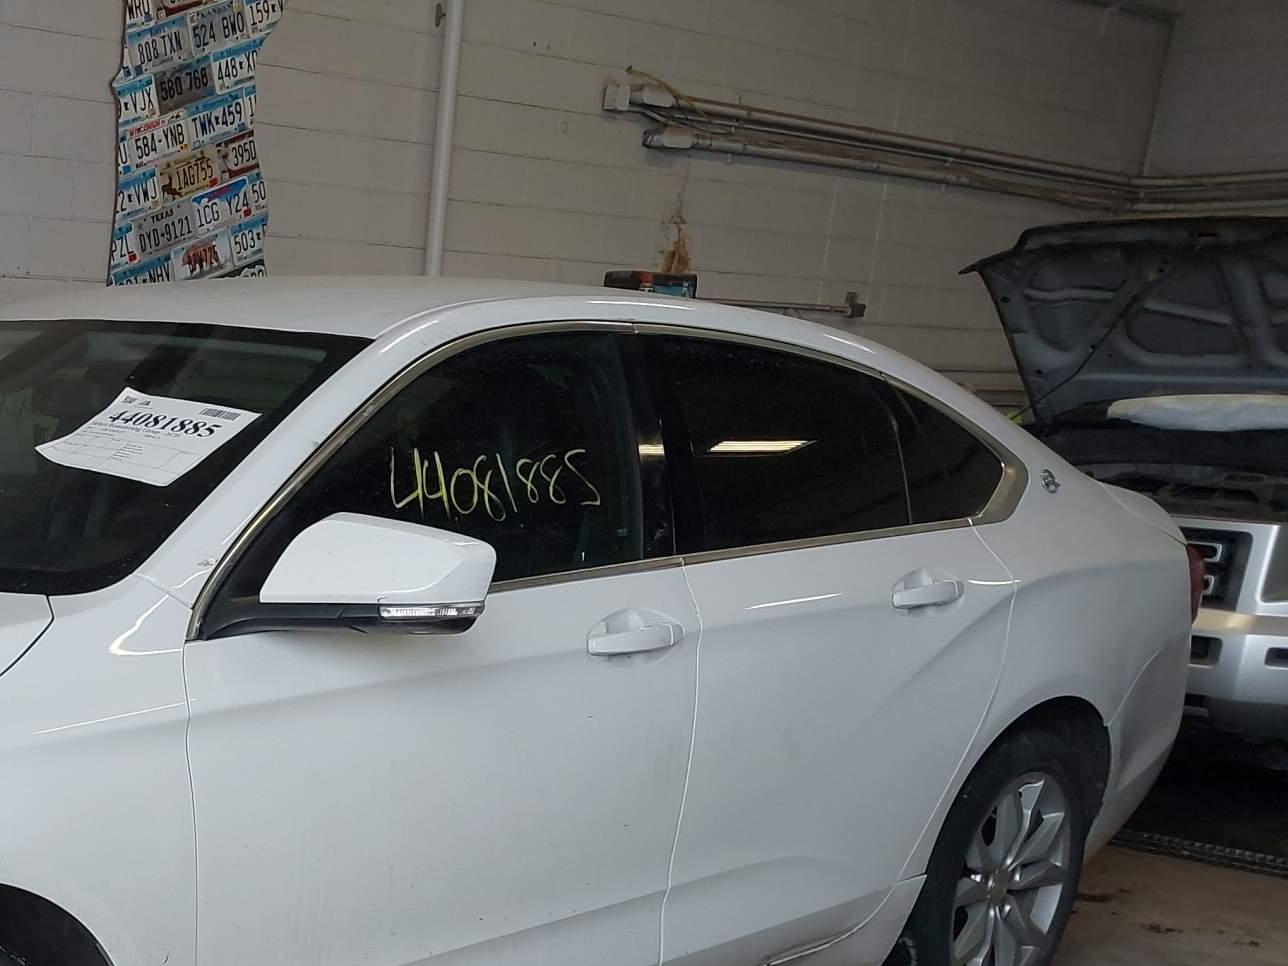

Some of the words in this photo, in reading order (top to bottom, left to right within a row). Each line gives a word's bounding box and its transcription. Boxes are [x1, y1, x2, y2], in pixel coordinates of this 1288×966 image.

[249, 0, 270, 26] 159
[138, 40, 159, 64] 808
[162, 31, 183, 54] TXN
[193, 22, 216, 48] 524
[186, 67, 209, 91] 768
[217, 57, 238, 82] 448
[129, 87, 154, 114] VJX
[192, 113, 215, 139] TWK
[222, 102, 243, 127] 459
[133, 177, 158, 206] VWJ
[251, 181, 267, 204] 50
[151, 208, 175, 224] TEXAS
[196, 202, 220, 229] 1CG
[226, 191, 249, 216] Y24
[234, 229, 256, 255] 503
[148, 262, 170, 283] NHV
[108, 410, 223, 438] 44081885
[390, 446, 601, 522] 44081885
